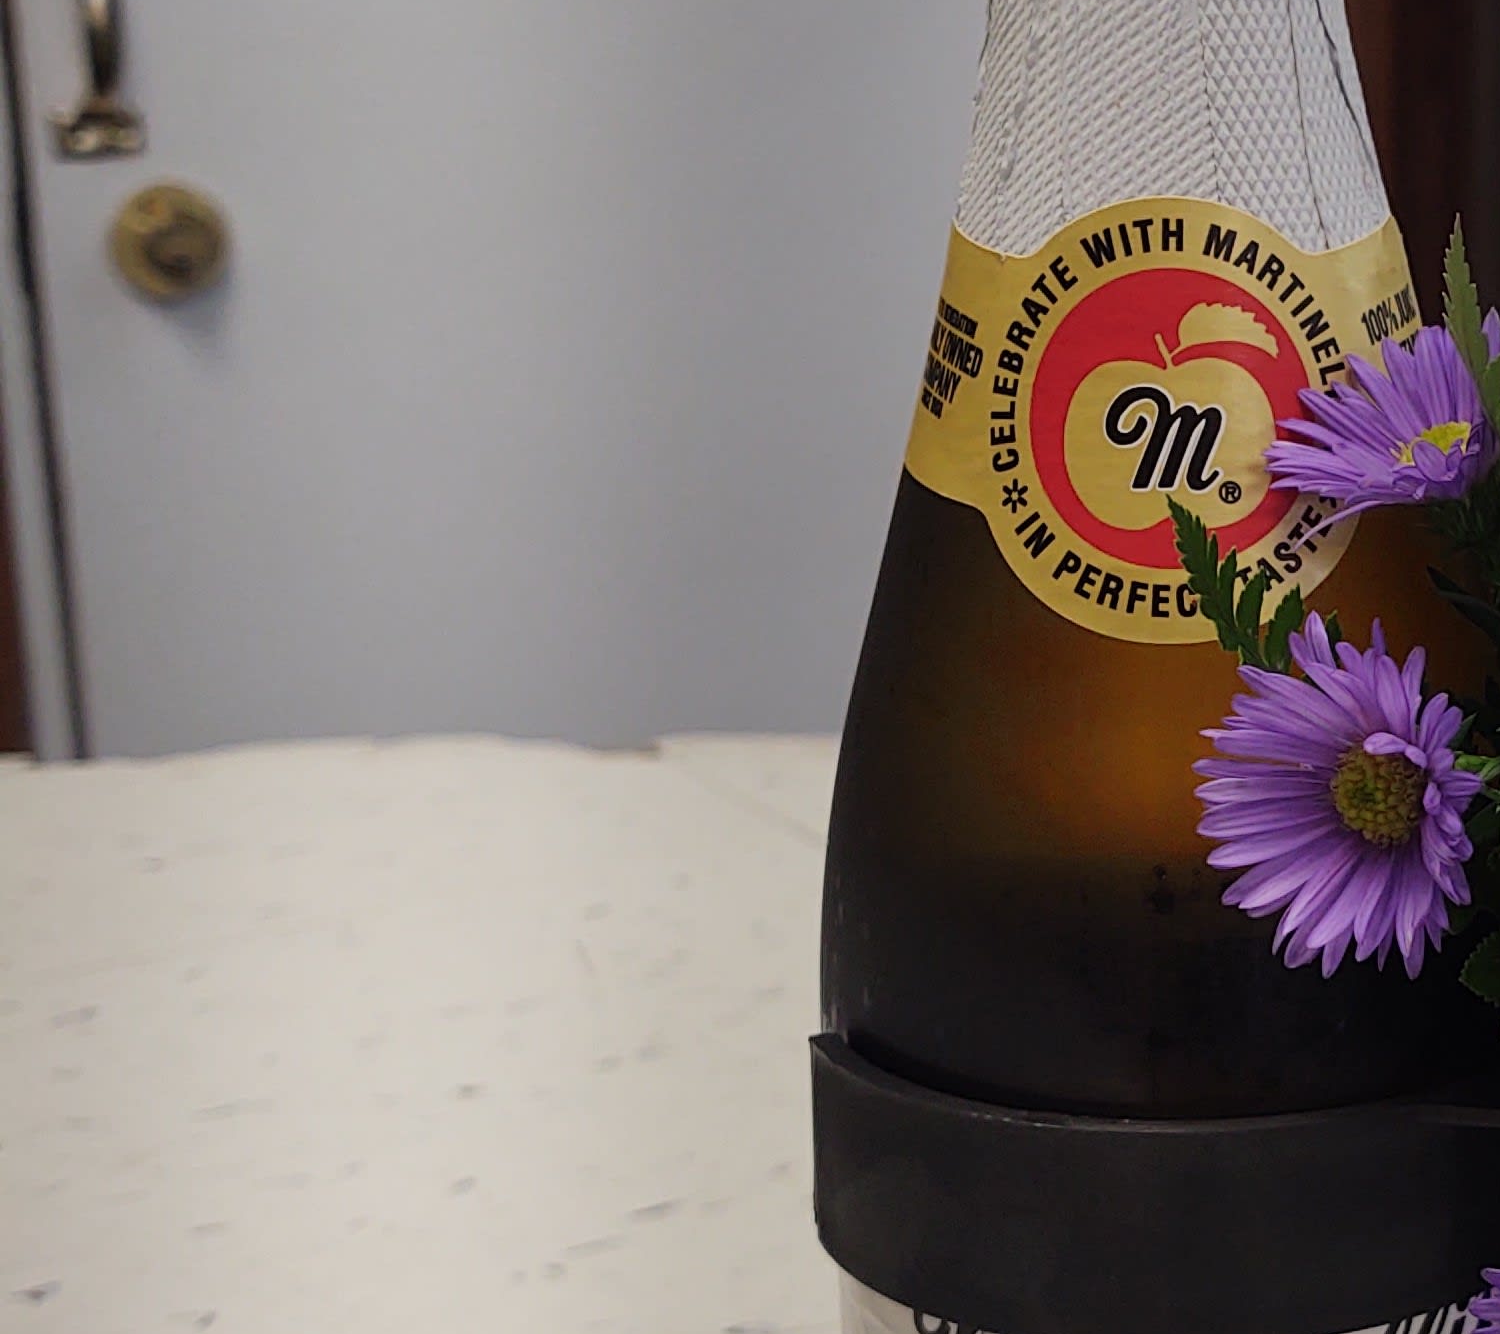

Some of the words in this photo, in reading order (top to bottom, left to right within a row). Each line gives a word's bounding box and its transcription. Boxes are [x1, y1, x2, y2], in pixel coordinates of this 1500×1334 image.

[990, 255, 1079, 473] CELEBRATE
[1080, 218, 1184, 269] WITH
[1202, 223, 1345, 398] MARTINEL
[1014, 510, 1056, 560] IN
[1051, 549, 1198, 619] PERFEC
